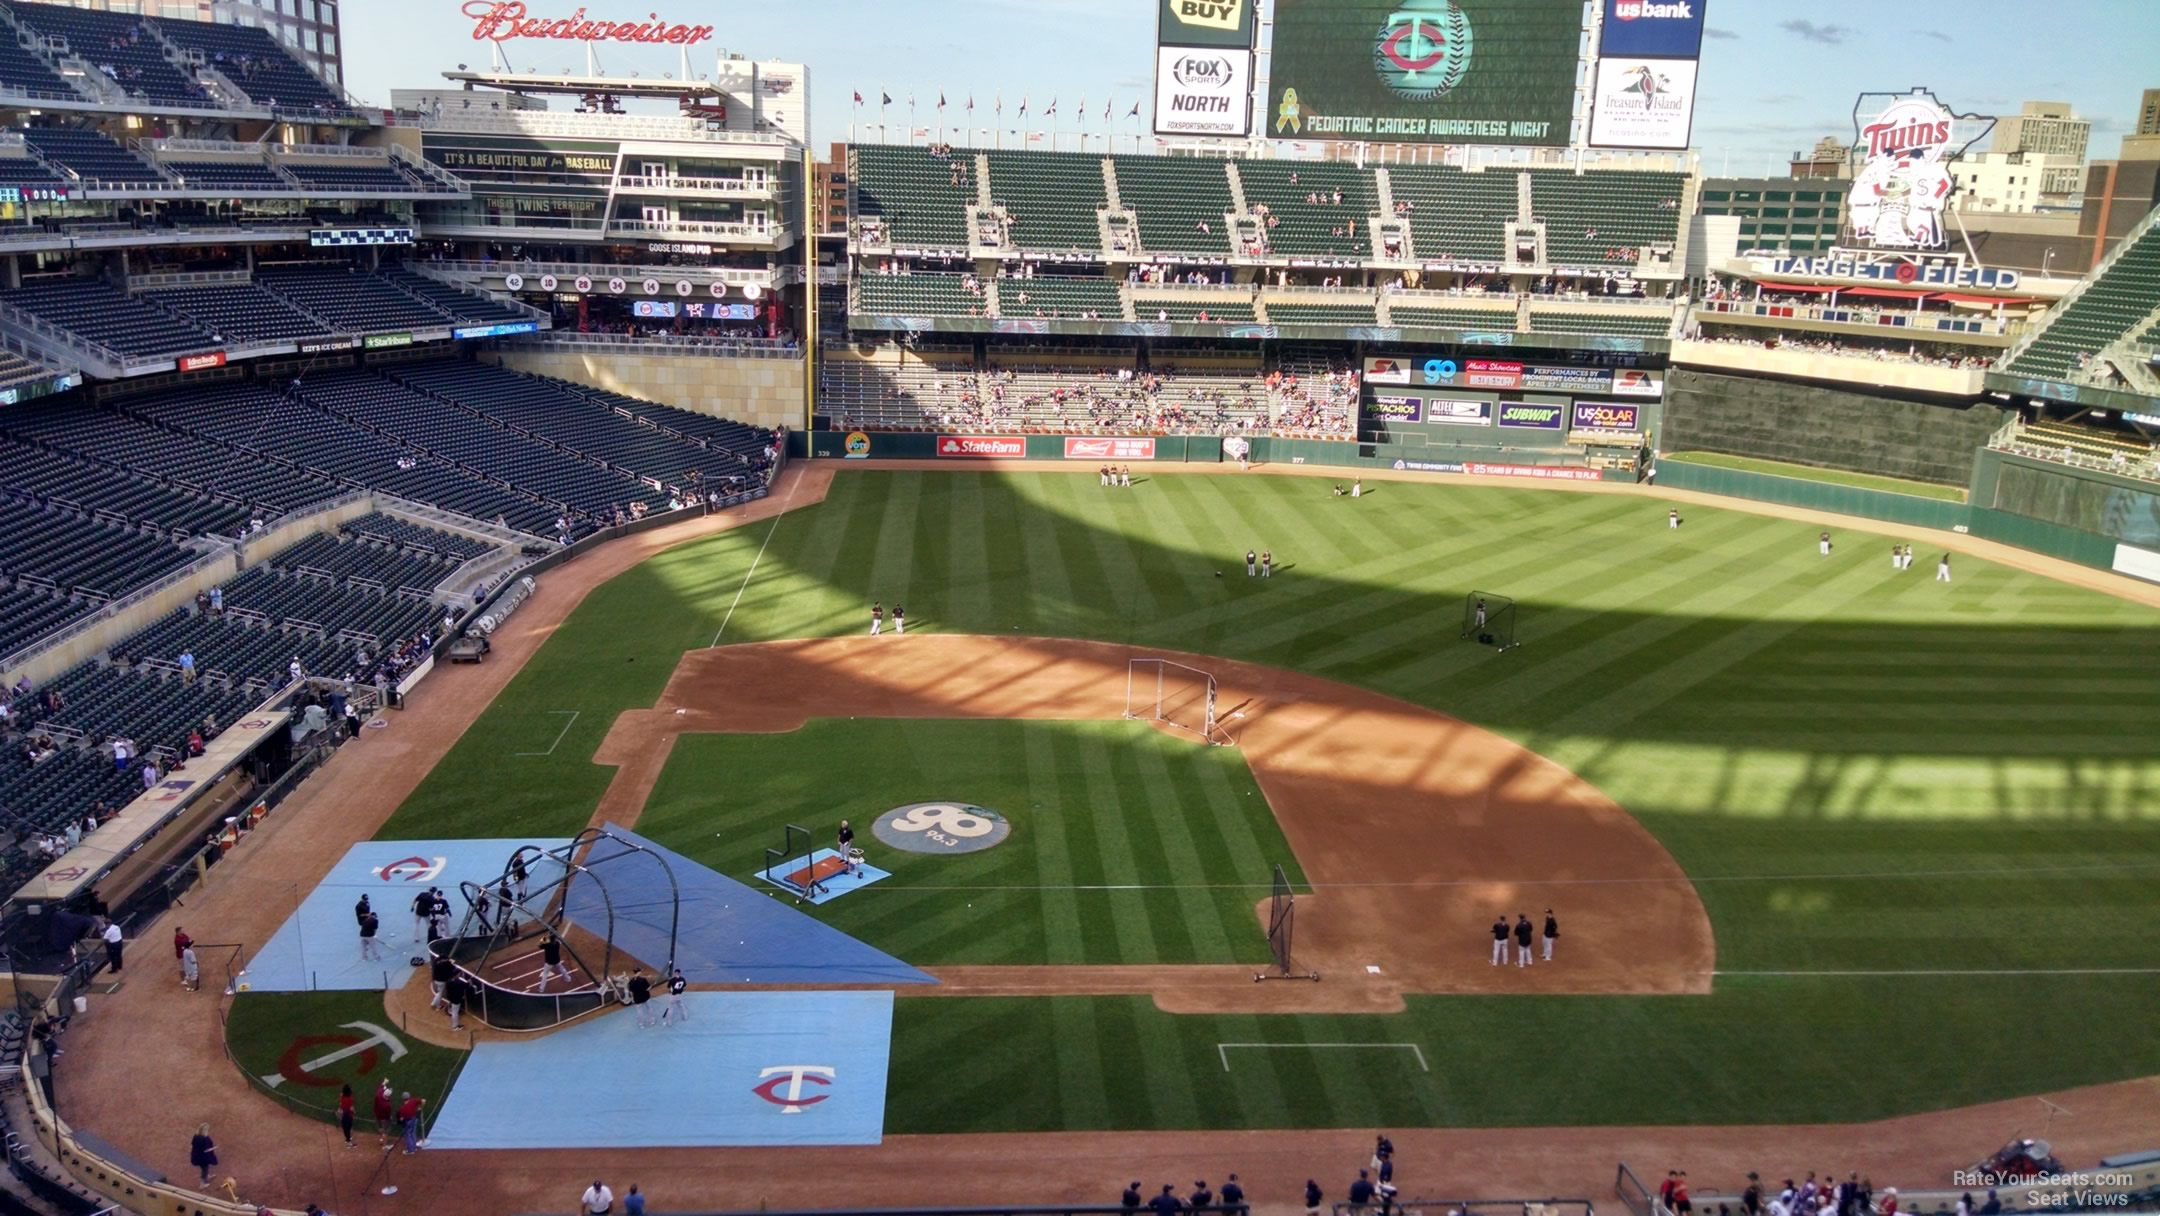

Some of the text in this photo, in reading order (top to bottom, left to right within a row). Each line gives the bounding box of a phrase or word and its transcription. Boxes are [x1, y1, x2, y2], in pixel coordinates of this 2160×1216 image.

[1181, 1, 1234, 21] BUY
[461, 0, 714, 44] Budweiser
[1186, 59, 1220, 77] FOX
[1185, 76, 1221, 84] SPORTS
[1171, 94, 1230, 112] NORTH
[1605, 94, 1682, 110] Treasure Island
[1167, 121, 1235, 131] FOXSPORTSNORTH.COM
[1307, 116, 1550, 138] PEDIATRIC CANCER AWARENESS NIGHT
[1863, 117, 1950, 159] Twins
[444, 153, 465, 165] IT'S
[468, 154, 474, 164] A
[477, 154, 528, 167] BEAUTIFUL
[531, 156, 547, 167] DAY
[565, 157, 612, 170] BASEBALL
[487, 198, 595, 212] THIS IS TWINS TERRITORY
[649, 244, 671, 253] GOOSE
[672, 244, 696, 254] ISLAND
[696, 245, 711, 255] PUB
[1774, 257, 2020, 289] TARGET FIELD
[509, 278, 519, 286] 42
[544, 279, 553, 287] 10
[612, 281, 622, 290] 34
[647, 283, 655, 291] 14
[682, 283, 687, 292] 6
[302, 342, 351, 353] IZZY'S ICE CREAM
[1424, 360, 1457, 384] go
[1466, 362, 1521, 372] Music Showcase
[1534, 368, 1588, 377] PERFORMANCES
[1522, 374, 1563, 382] PROMINENT
[1560, 382, 1600, 390] SEPTEMBER
[1366, 403, 1416, 414] PISTACHIOS
[1502, 407, 1560, 422] SUBWAY
[1235, 442, 1248, 452] 29
[1473, 464, 1486, 474] 25
[1486, 466, 1505, 475] YEARS
[1546, 469, 1552, 477] A
[924, 830, 959, 847] 96.3
